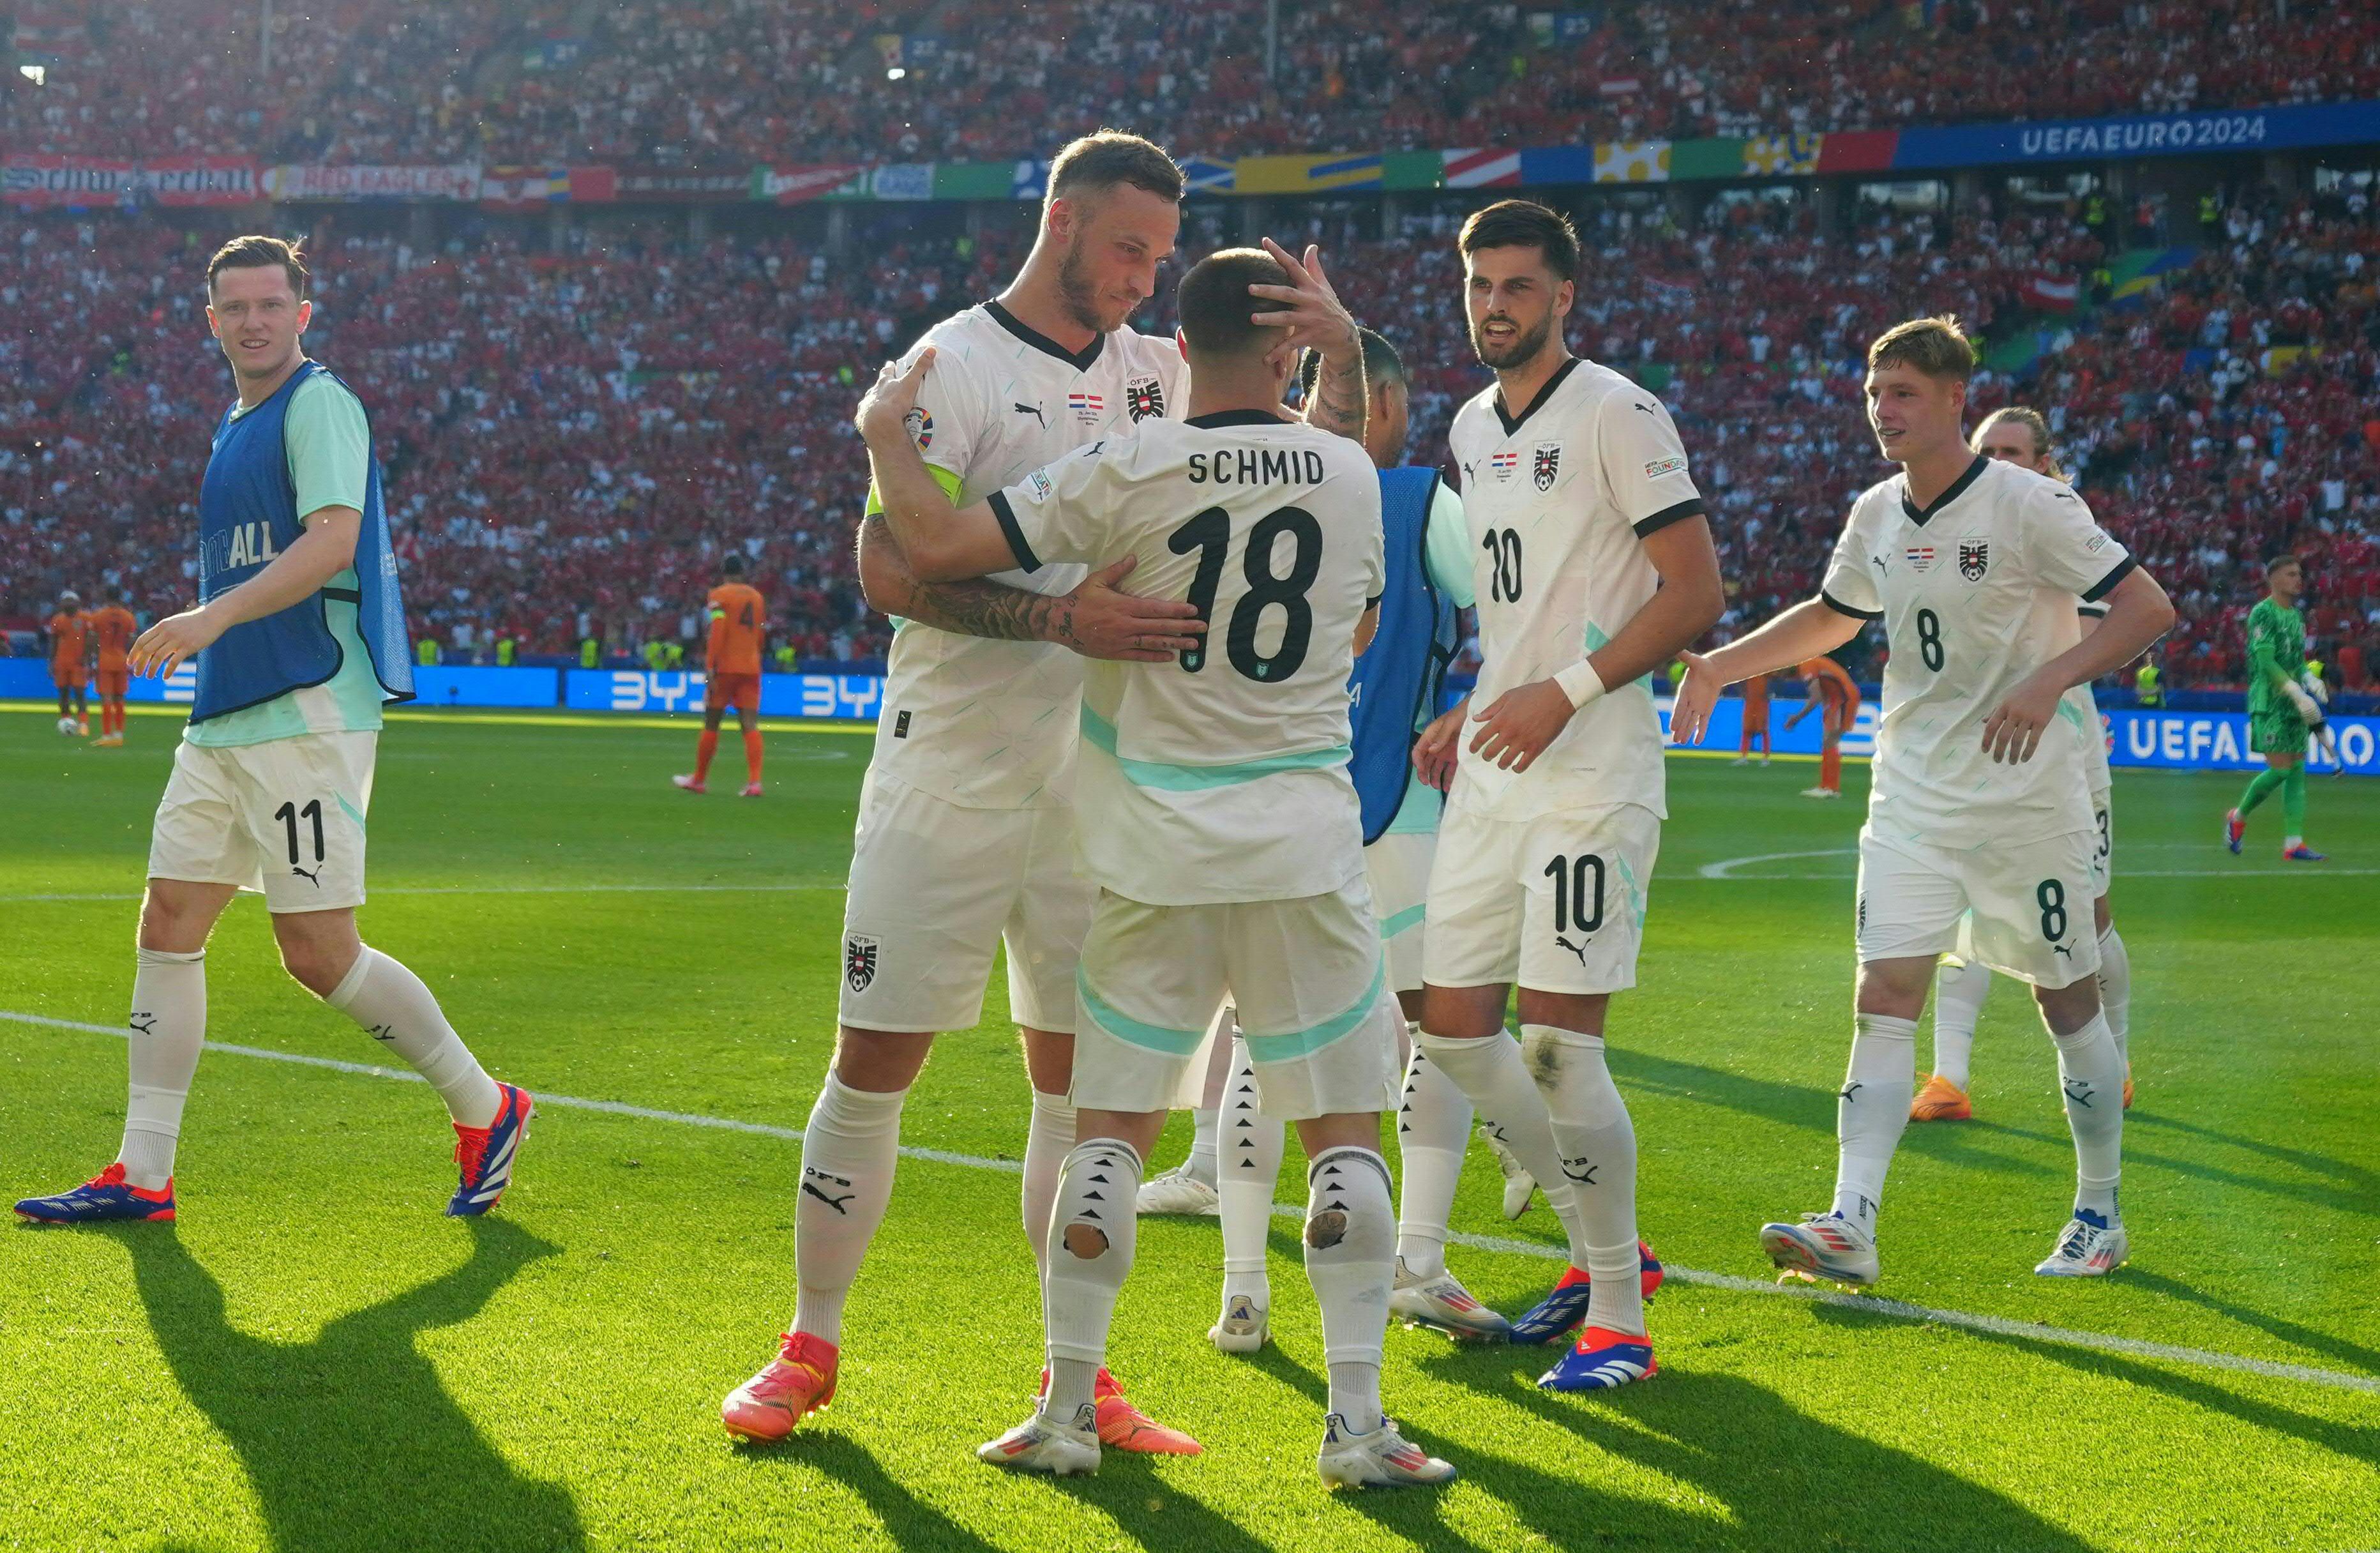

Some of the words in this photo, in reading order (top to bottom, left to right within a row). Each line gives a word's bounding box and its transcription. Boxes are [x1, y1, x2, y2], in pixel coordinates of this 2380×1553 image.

[1188, 449, 1323, 485] SCHMID
[1167, 506, 1323, 683] 18
[1482, 528, 1522, 603] 10
[1917, 608, 1945, 672] 8
[275, 799, 324, 865] 11
[1544, 854, 1605, 933] 10
[2037, 879, 2067, 943] 8
